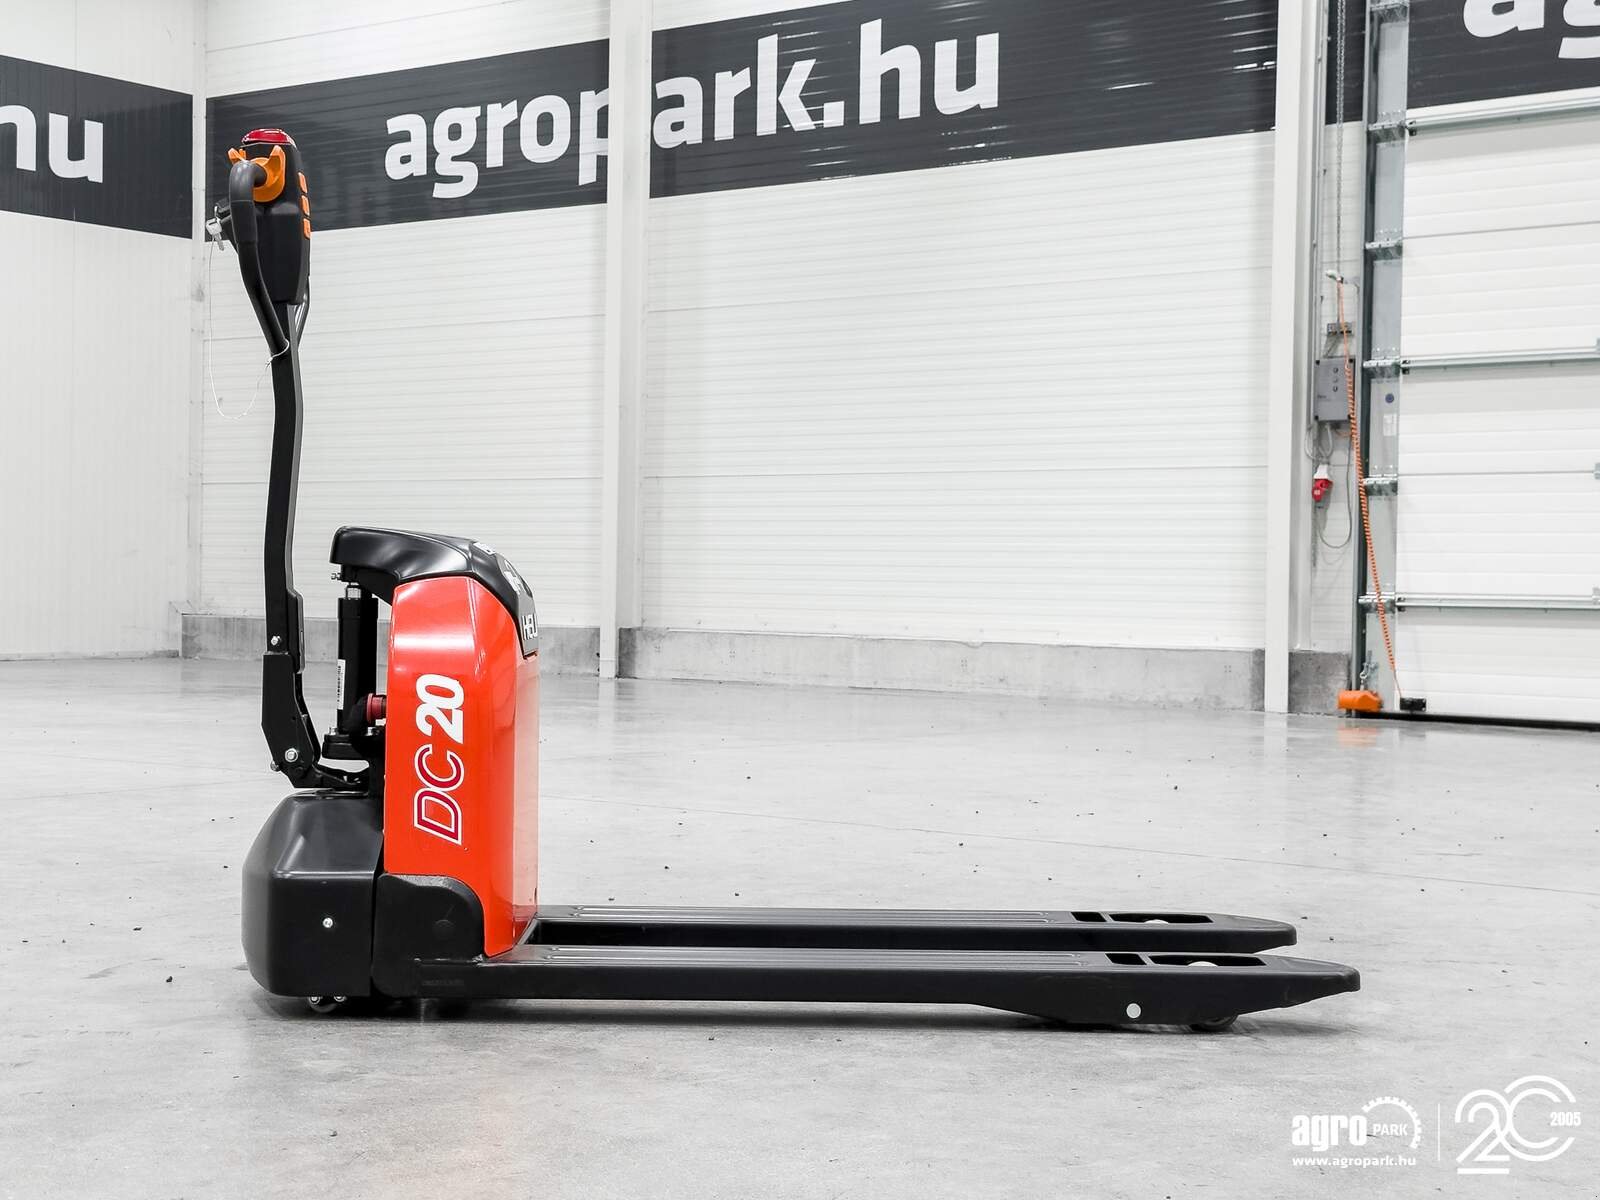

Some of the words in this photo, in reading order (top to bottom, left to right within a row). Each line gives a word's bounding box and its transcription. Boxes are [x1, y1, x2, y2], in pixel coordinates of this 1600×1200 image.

[384, 18, 1000, 199] agropark.hu
[415, 673, 465, 745] 20
[413, 743, 465, 846] DC
